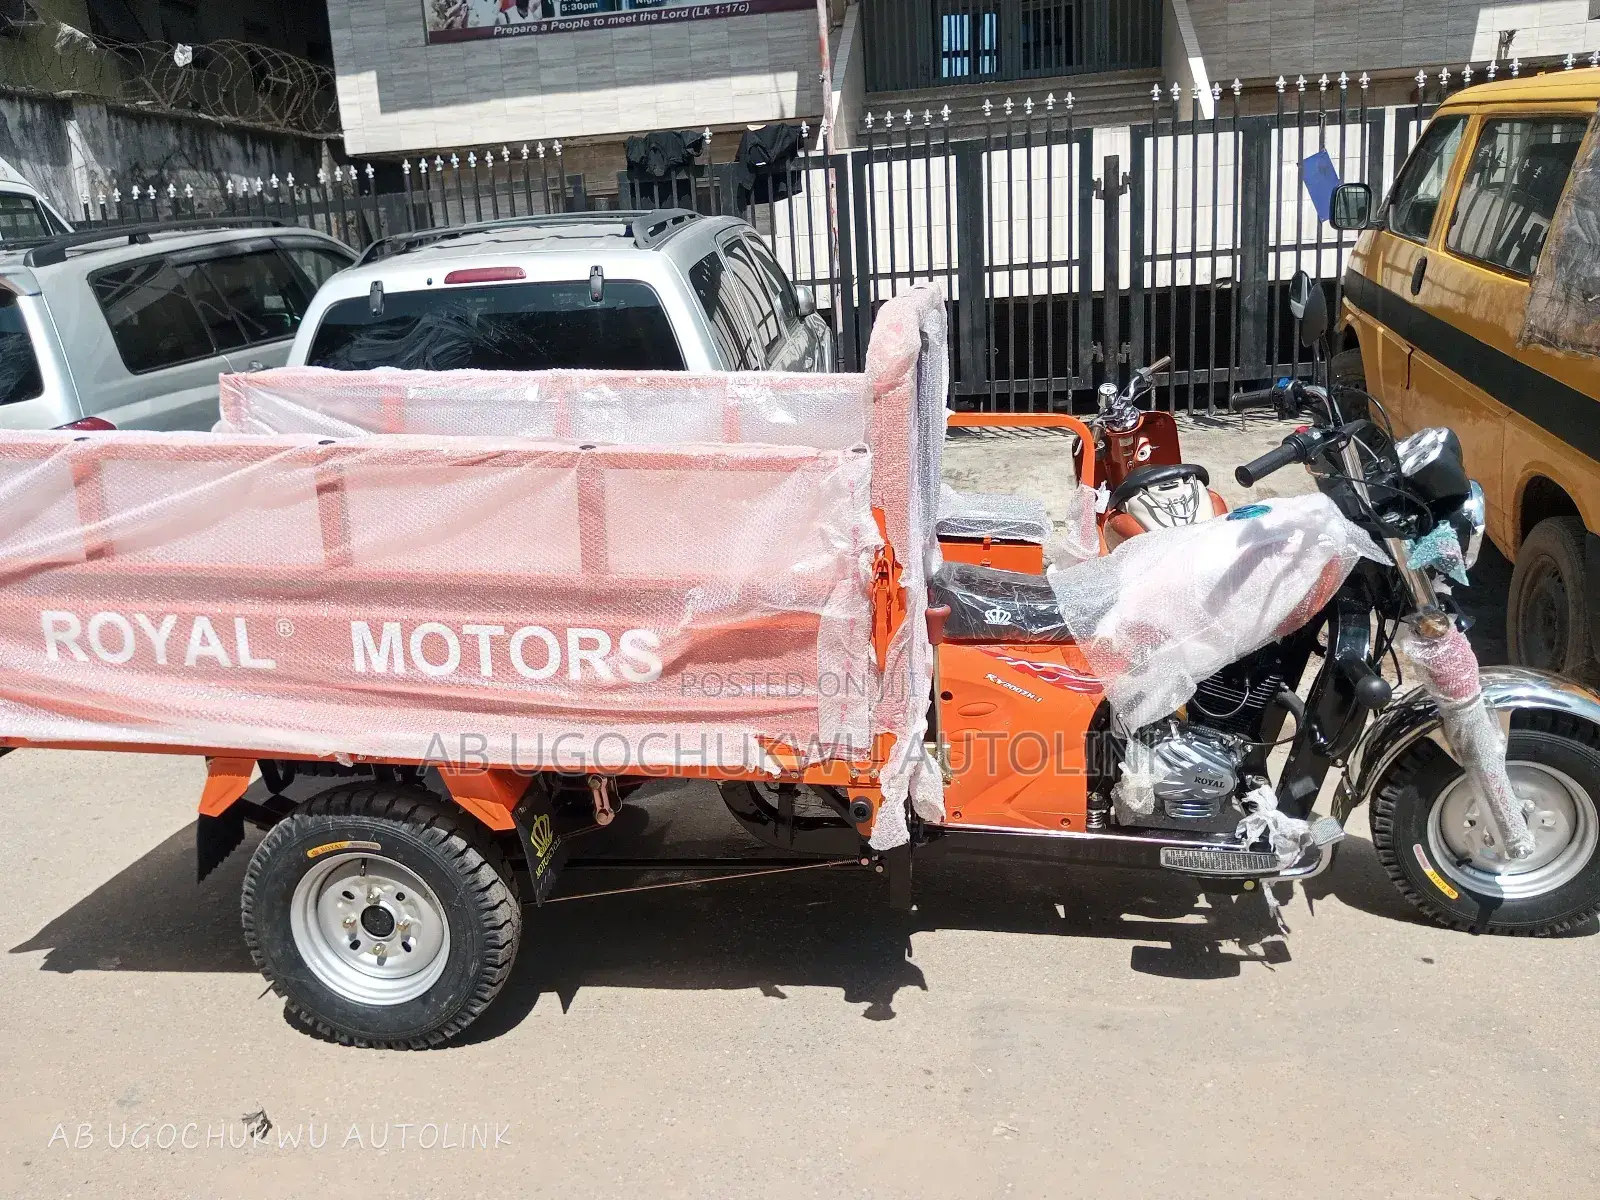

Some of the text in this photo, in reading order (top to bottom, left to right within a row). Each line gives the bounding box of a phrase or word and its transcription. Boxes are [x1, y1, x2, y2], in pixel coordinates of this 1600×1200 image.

[561, 2, 598, 12] 5:30pm
[493, 3, 750, 36] Prepare a People to meet the Lord (Lk 1:17c)
[40, 610, 277, 670] ROYAL
[350, 620, 663, 684] MOTORS
[1194, 776, 1226, 789] ROYAL
[320, 844, 344, 852] ROYAL
